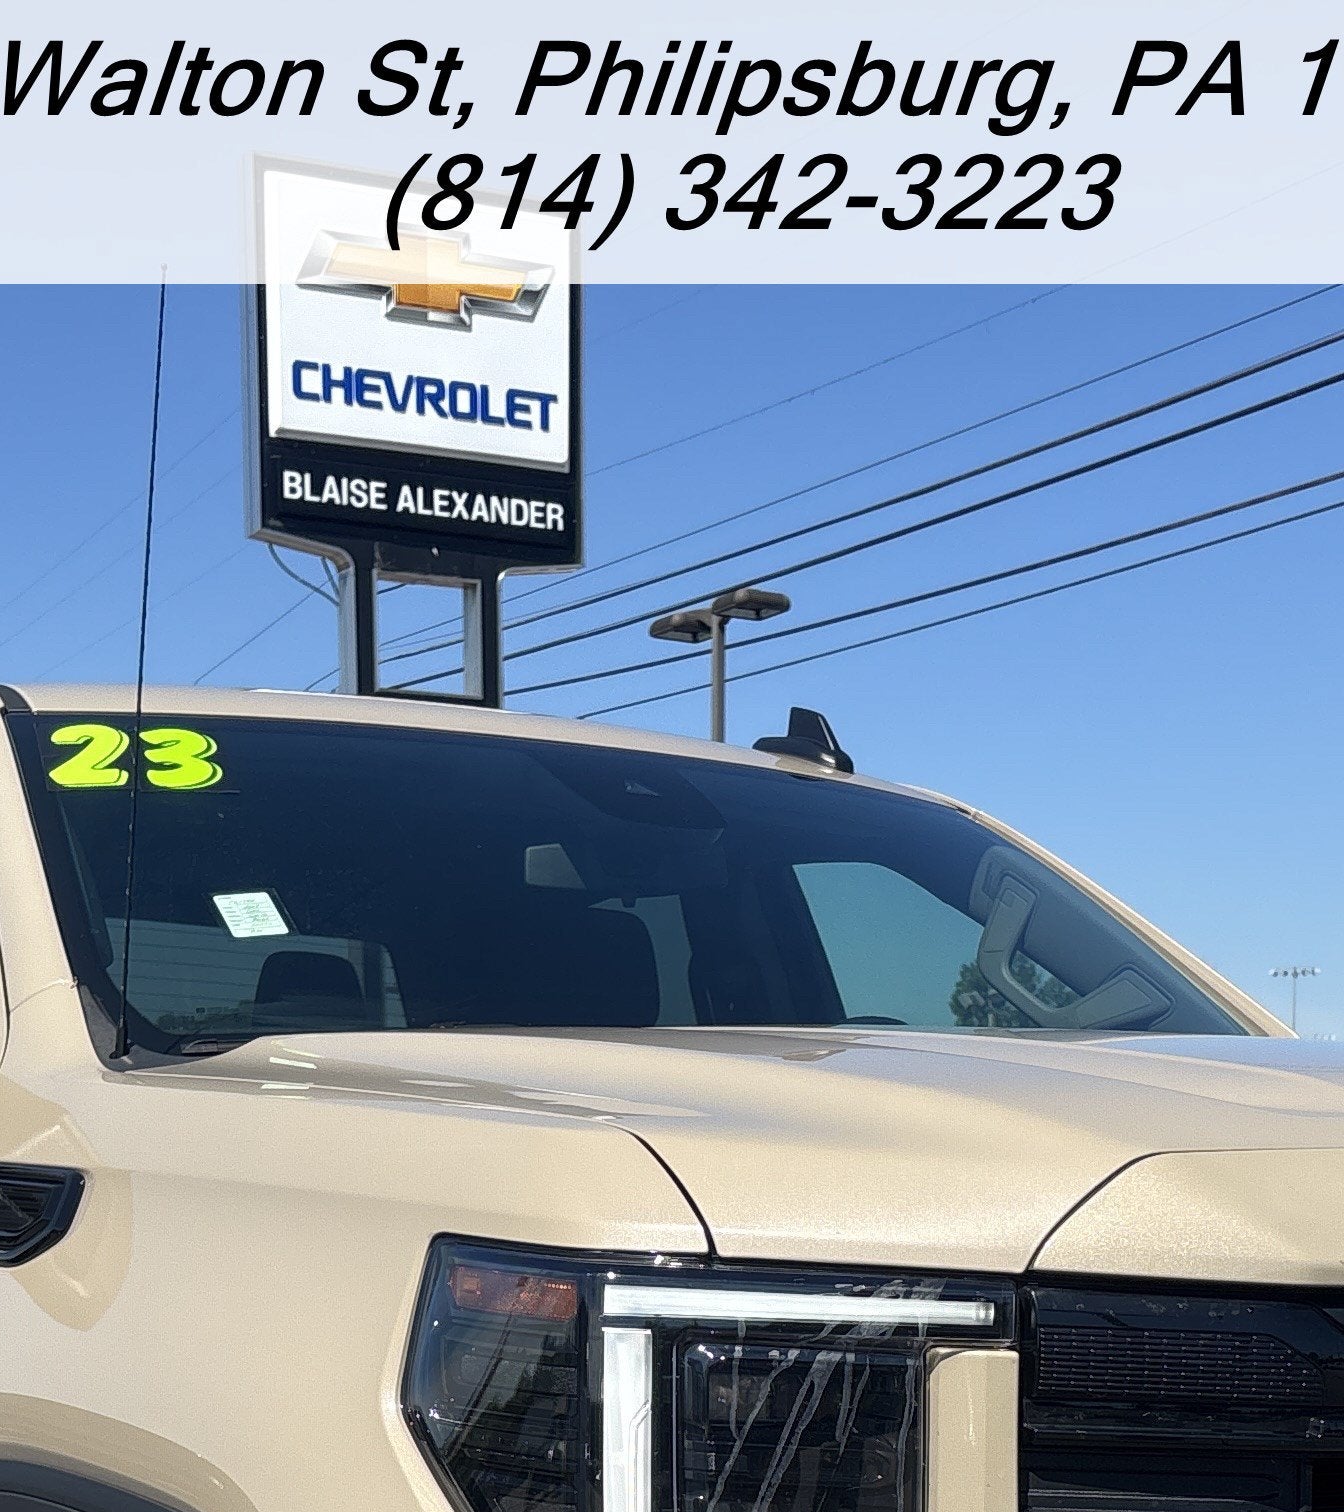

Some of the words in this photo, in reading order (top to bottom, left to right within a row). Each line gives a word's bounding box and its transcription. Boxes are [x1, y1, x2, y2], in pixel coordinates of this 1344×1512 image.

[291, 359, 558, 433] CHEVROLET
[281, 470, 388, 511] BLAISE
[395, 484, 566, 532] ALEXANDER
[48, 723, 224, 790] 23
